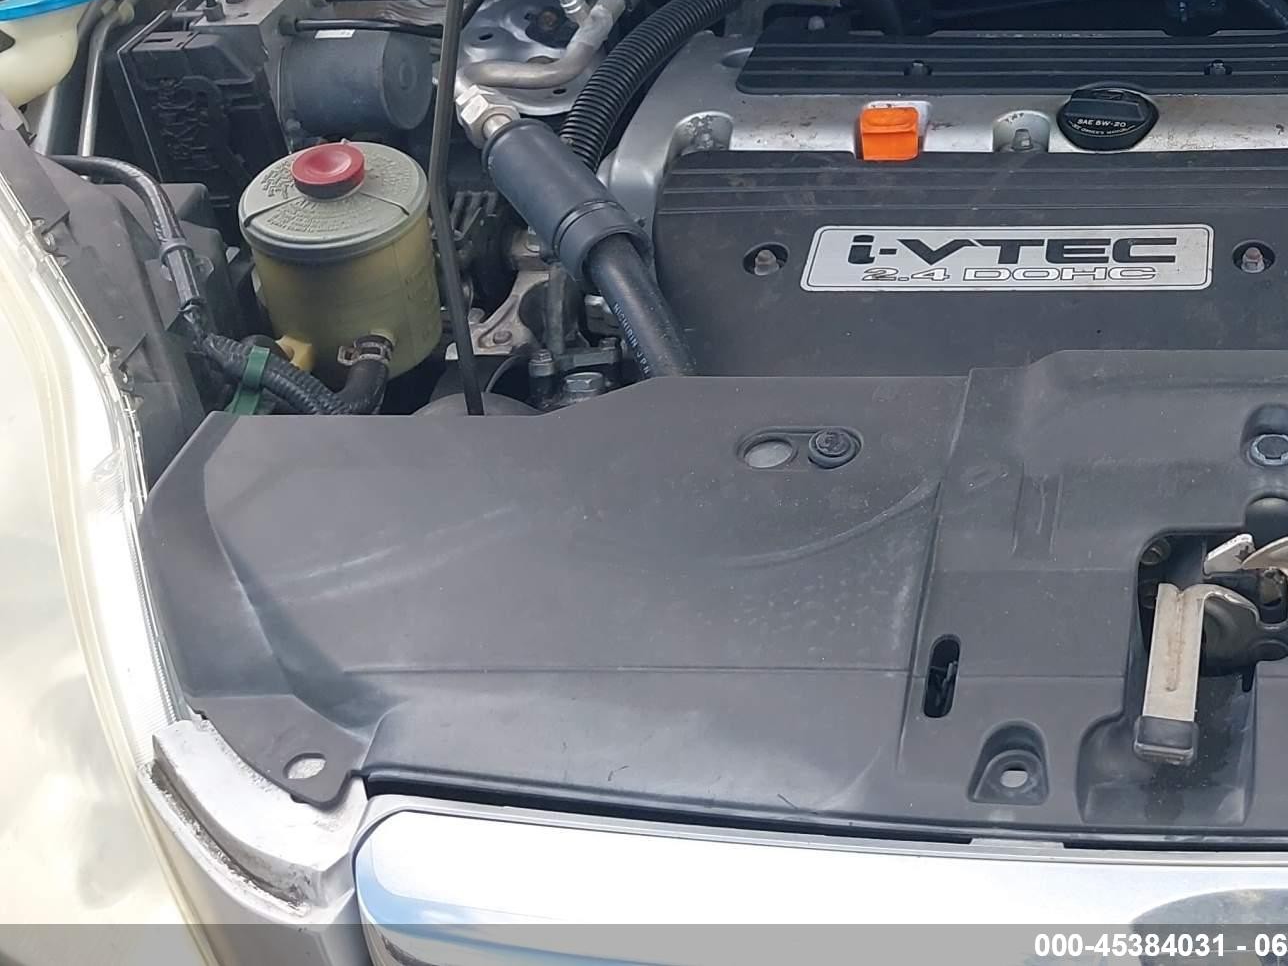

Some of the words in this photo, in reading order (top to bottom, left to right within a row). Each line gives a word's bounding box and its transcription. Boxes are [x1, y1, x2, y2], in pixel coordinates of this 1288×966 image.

[848, 234, 1177, 265] i-VTEC
[862, 266, 950, 282] 2.4
[963, 266, 1157, 282] DOHC
